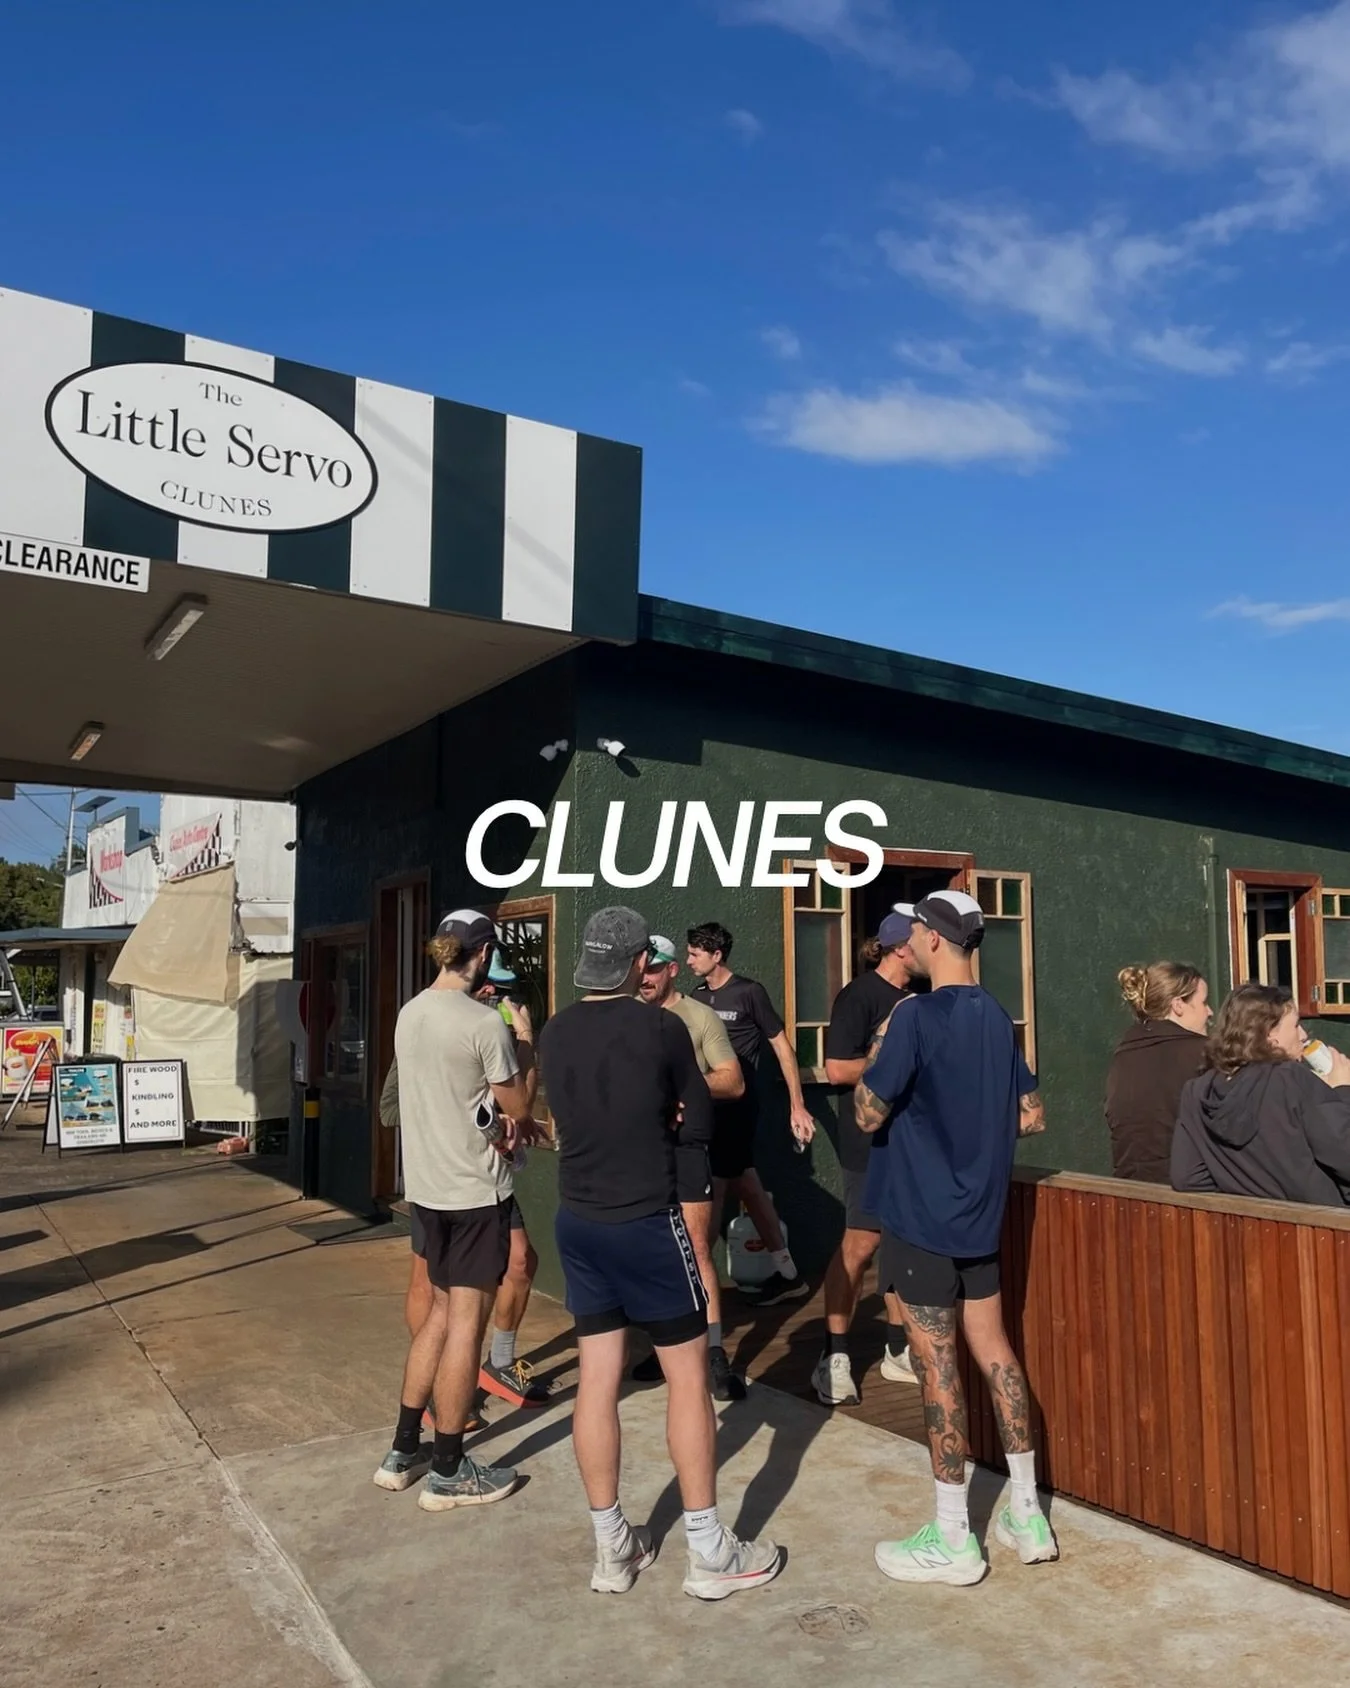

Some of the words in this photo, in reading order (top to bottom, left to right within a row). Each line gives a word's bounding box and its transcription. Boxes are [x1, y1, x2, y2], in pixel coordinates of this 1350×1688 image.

[199, 381, 243, 407] The
[76, 389, 207, 458] Little
[226, 423, 352, 489] Servo
[160, 479, 272, 517] CLUNES
[128, 1066, 148, 1074] FIRE
[149, 1065, 177, 1073] WOOD
[132, 1092, 174, 1101] KINDLING
[135, 1108, 140, 1116] $
[130, 1121, 149, 1129] AND
[150, 1119, 177, 1127] MORE
